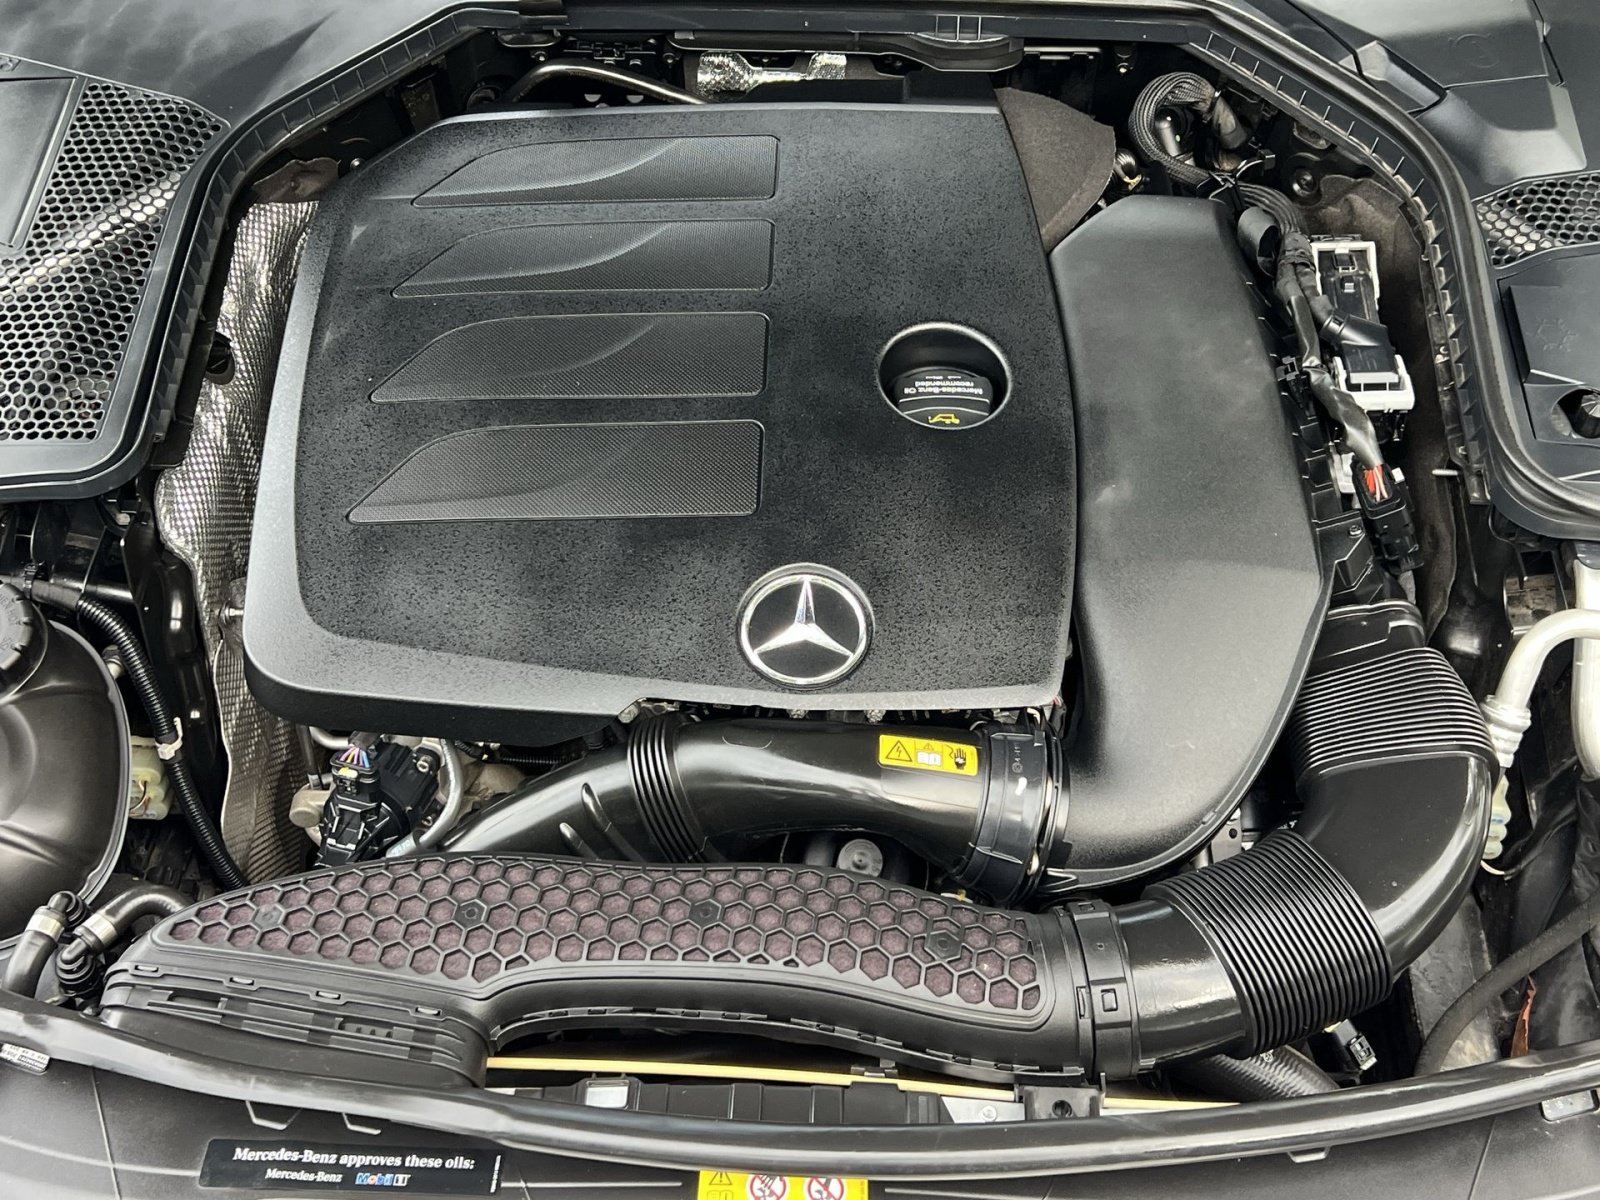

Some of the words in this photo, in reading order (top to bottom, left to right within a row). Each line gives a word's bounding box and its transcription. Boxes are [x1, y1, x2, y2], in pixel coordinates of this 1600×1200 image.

[232, 1147, 337, 1164] Mercedes-Benz
[339, 1154, 402, 1168] approves
[405, 1154, 442, 1168] these
[445, 1155, 475, 1170] oils:
[265, 1168, 343, 1183] Mercedes-Benz
[355, 1172, 393, 1186] Mobil
